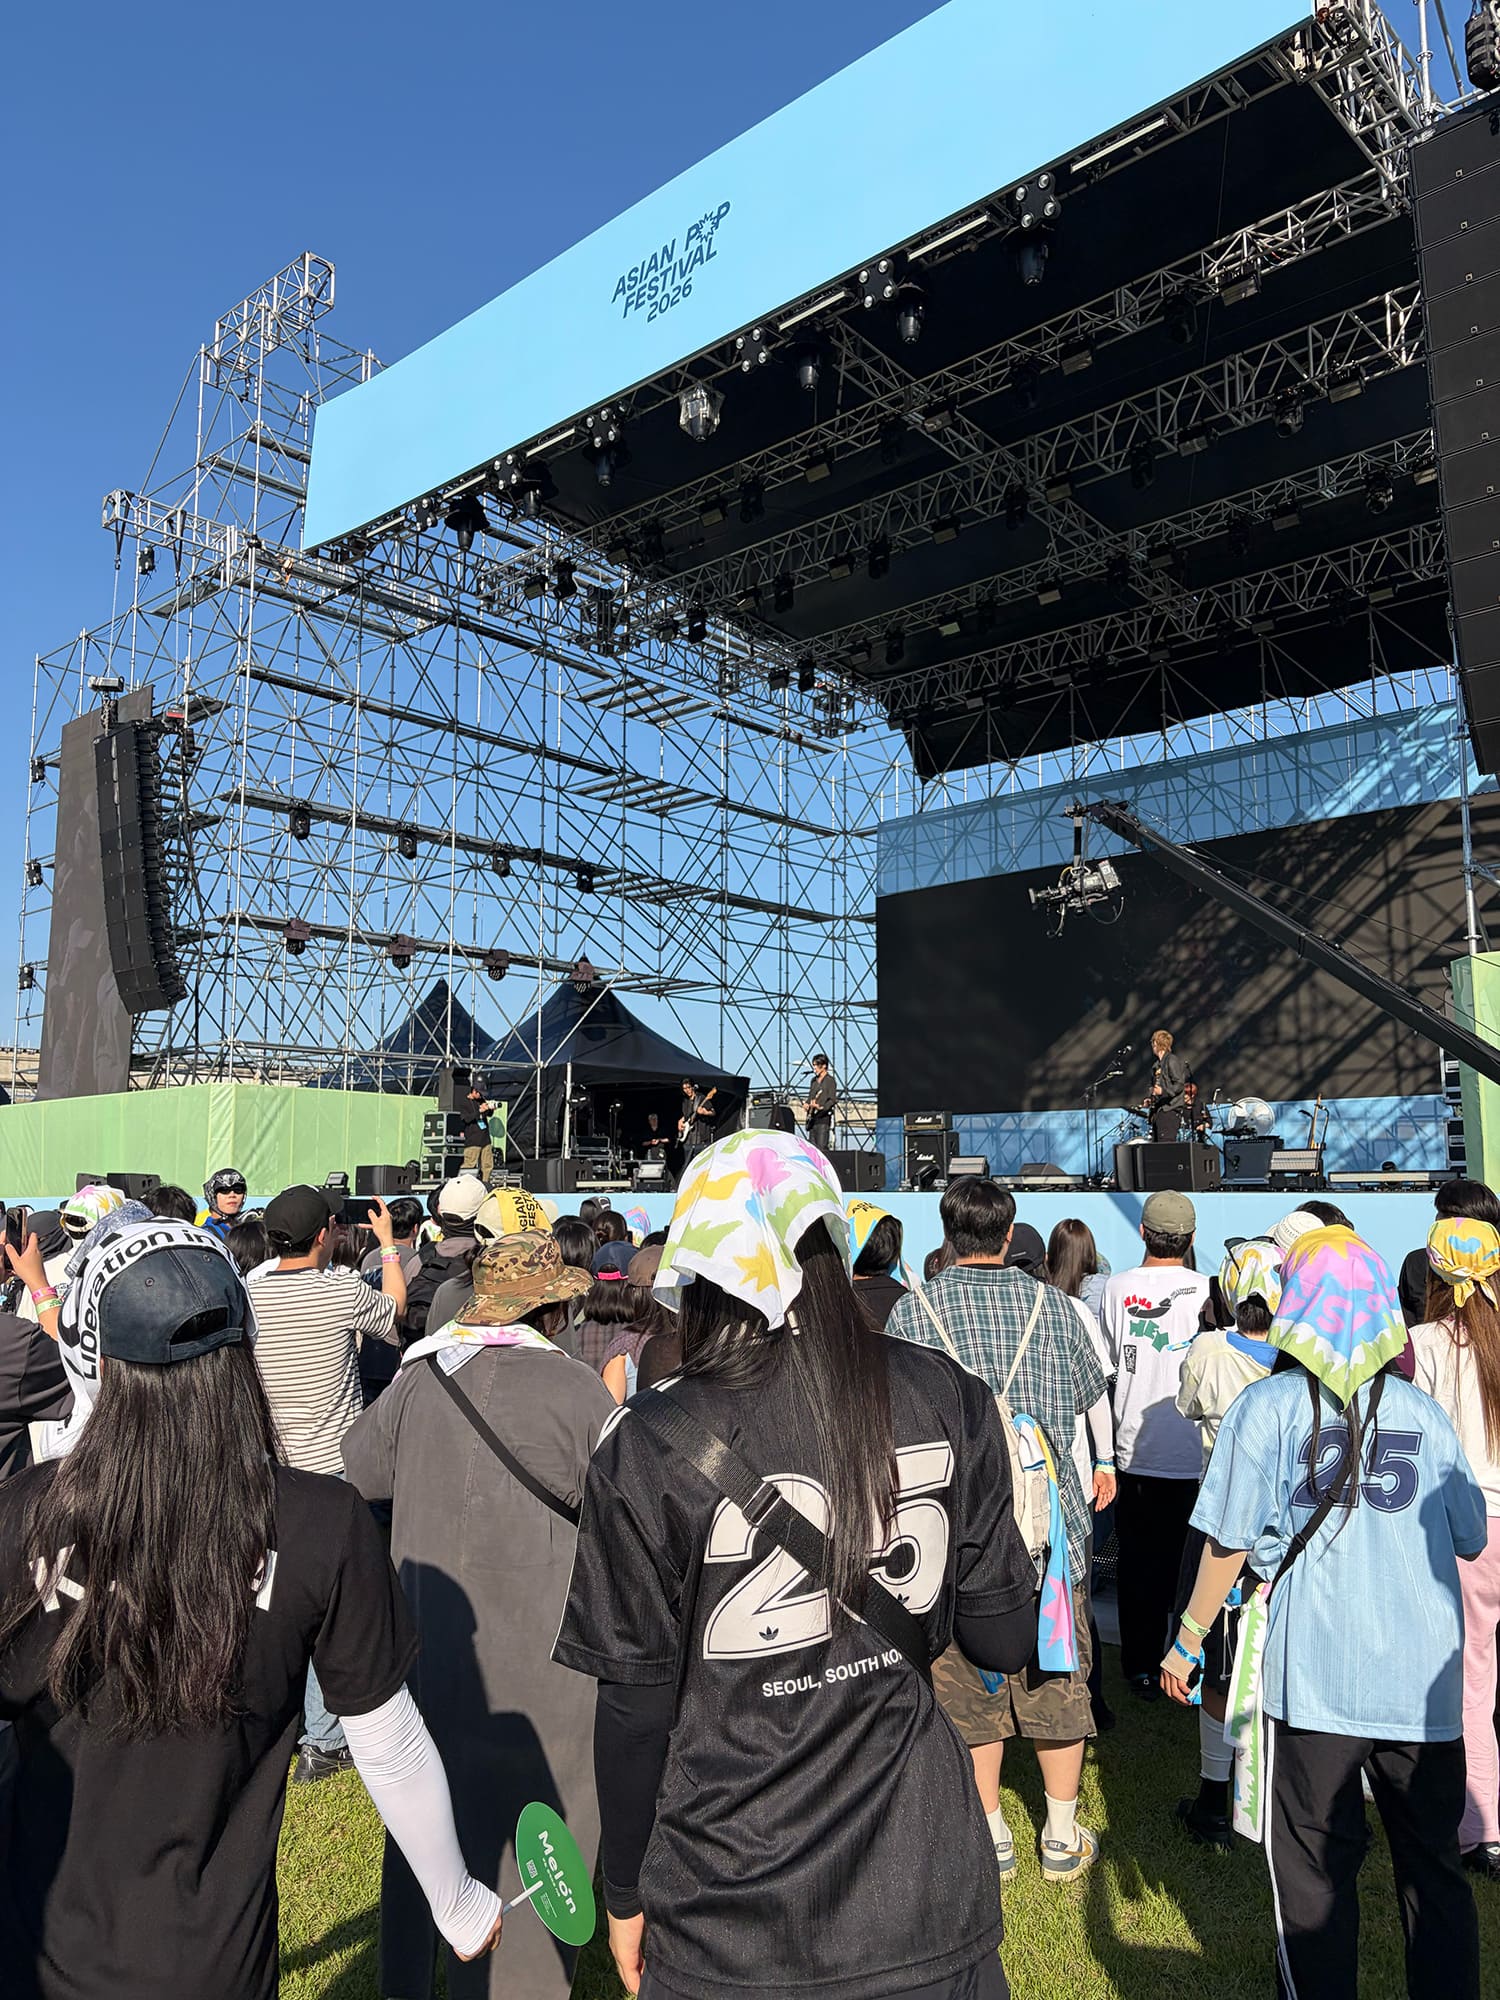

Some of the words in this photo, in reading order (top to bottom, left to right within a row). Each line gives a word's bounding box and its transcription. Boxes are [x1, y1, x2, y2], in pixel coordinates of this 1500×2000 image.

[611, 238, 676, 304] ASIAN
[623, 237, 718, 319] FESTIVAL
[647, 277, 693, 323] 2026
[1291, 1426, 1423, 1514] 25
[703, 1441, 955, 1660] 25
[762, 1675, 822, 1698] SEOUL,
[825, 1655, 880, 1684] SOUTH
[882, 1648, 903, 1667] KO
[538, 1830, 576, 1914] Melon
